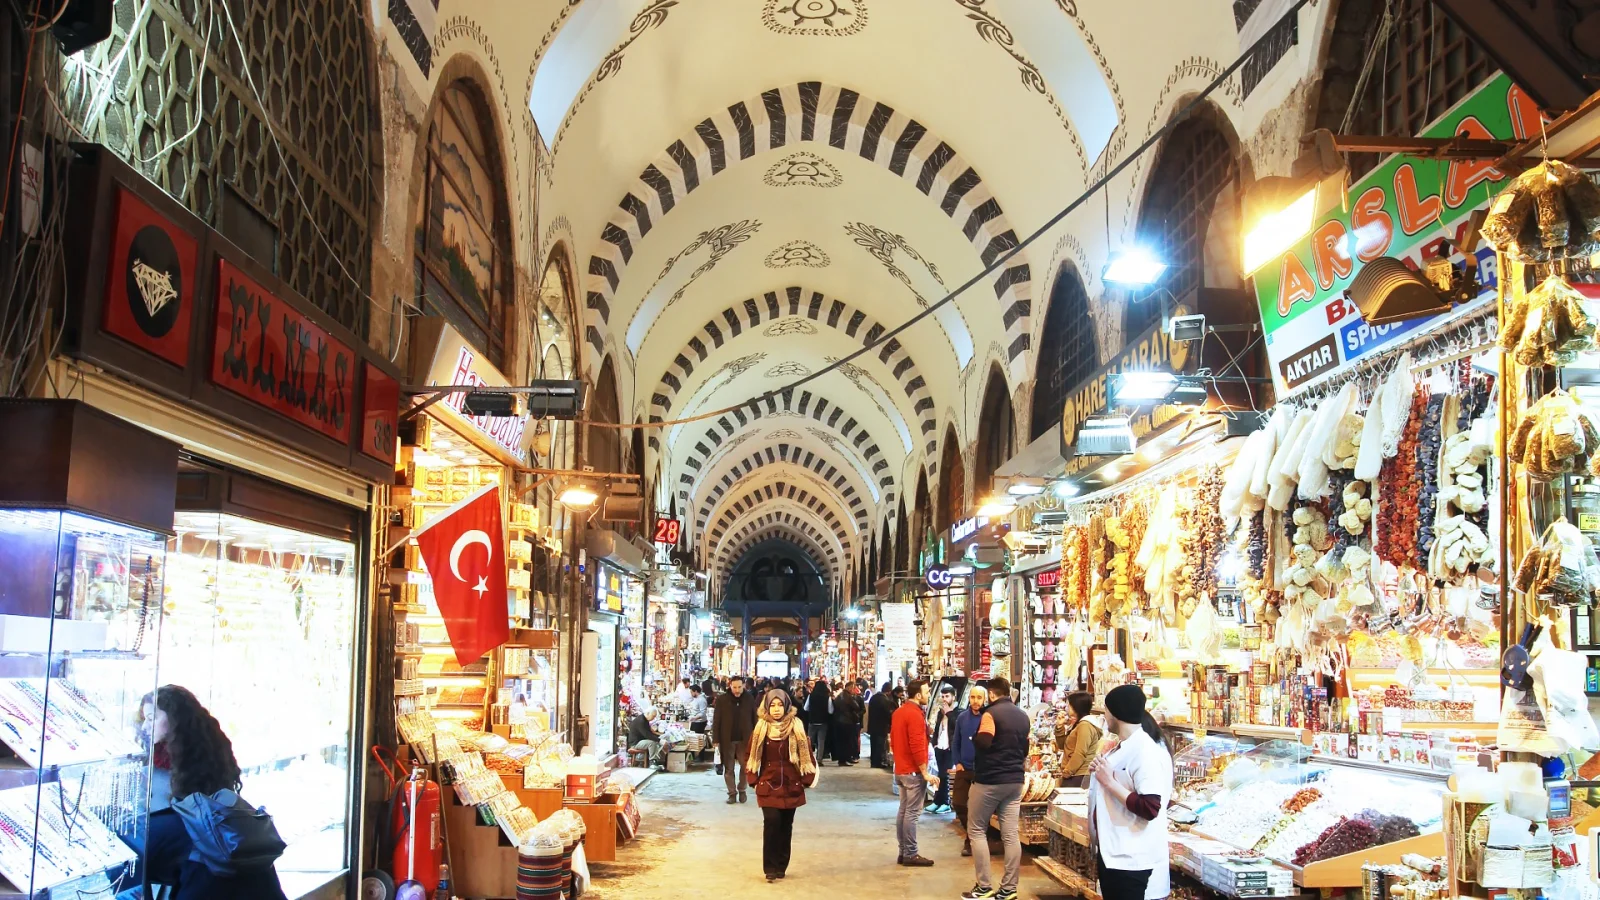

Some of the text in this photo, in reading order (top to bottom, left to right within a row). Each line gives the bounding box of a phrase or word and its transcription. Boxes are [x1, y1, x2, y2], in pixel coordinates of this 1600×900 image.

[223, 277, 349, 430] ELMAS
[1121, 326, 1169, 374] SARAY
[1287, 344, 1333, 384] AKTAR
[374, 418, 393, 456] 38
[655, 519, 679, 543] 28
[928, 570, 952, 584] CG
